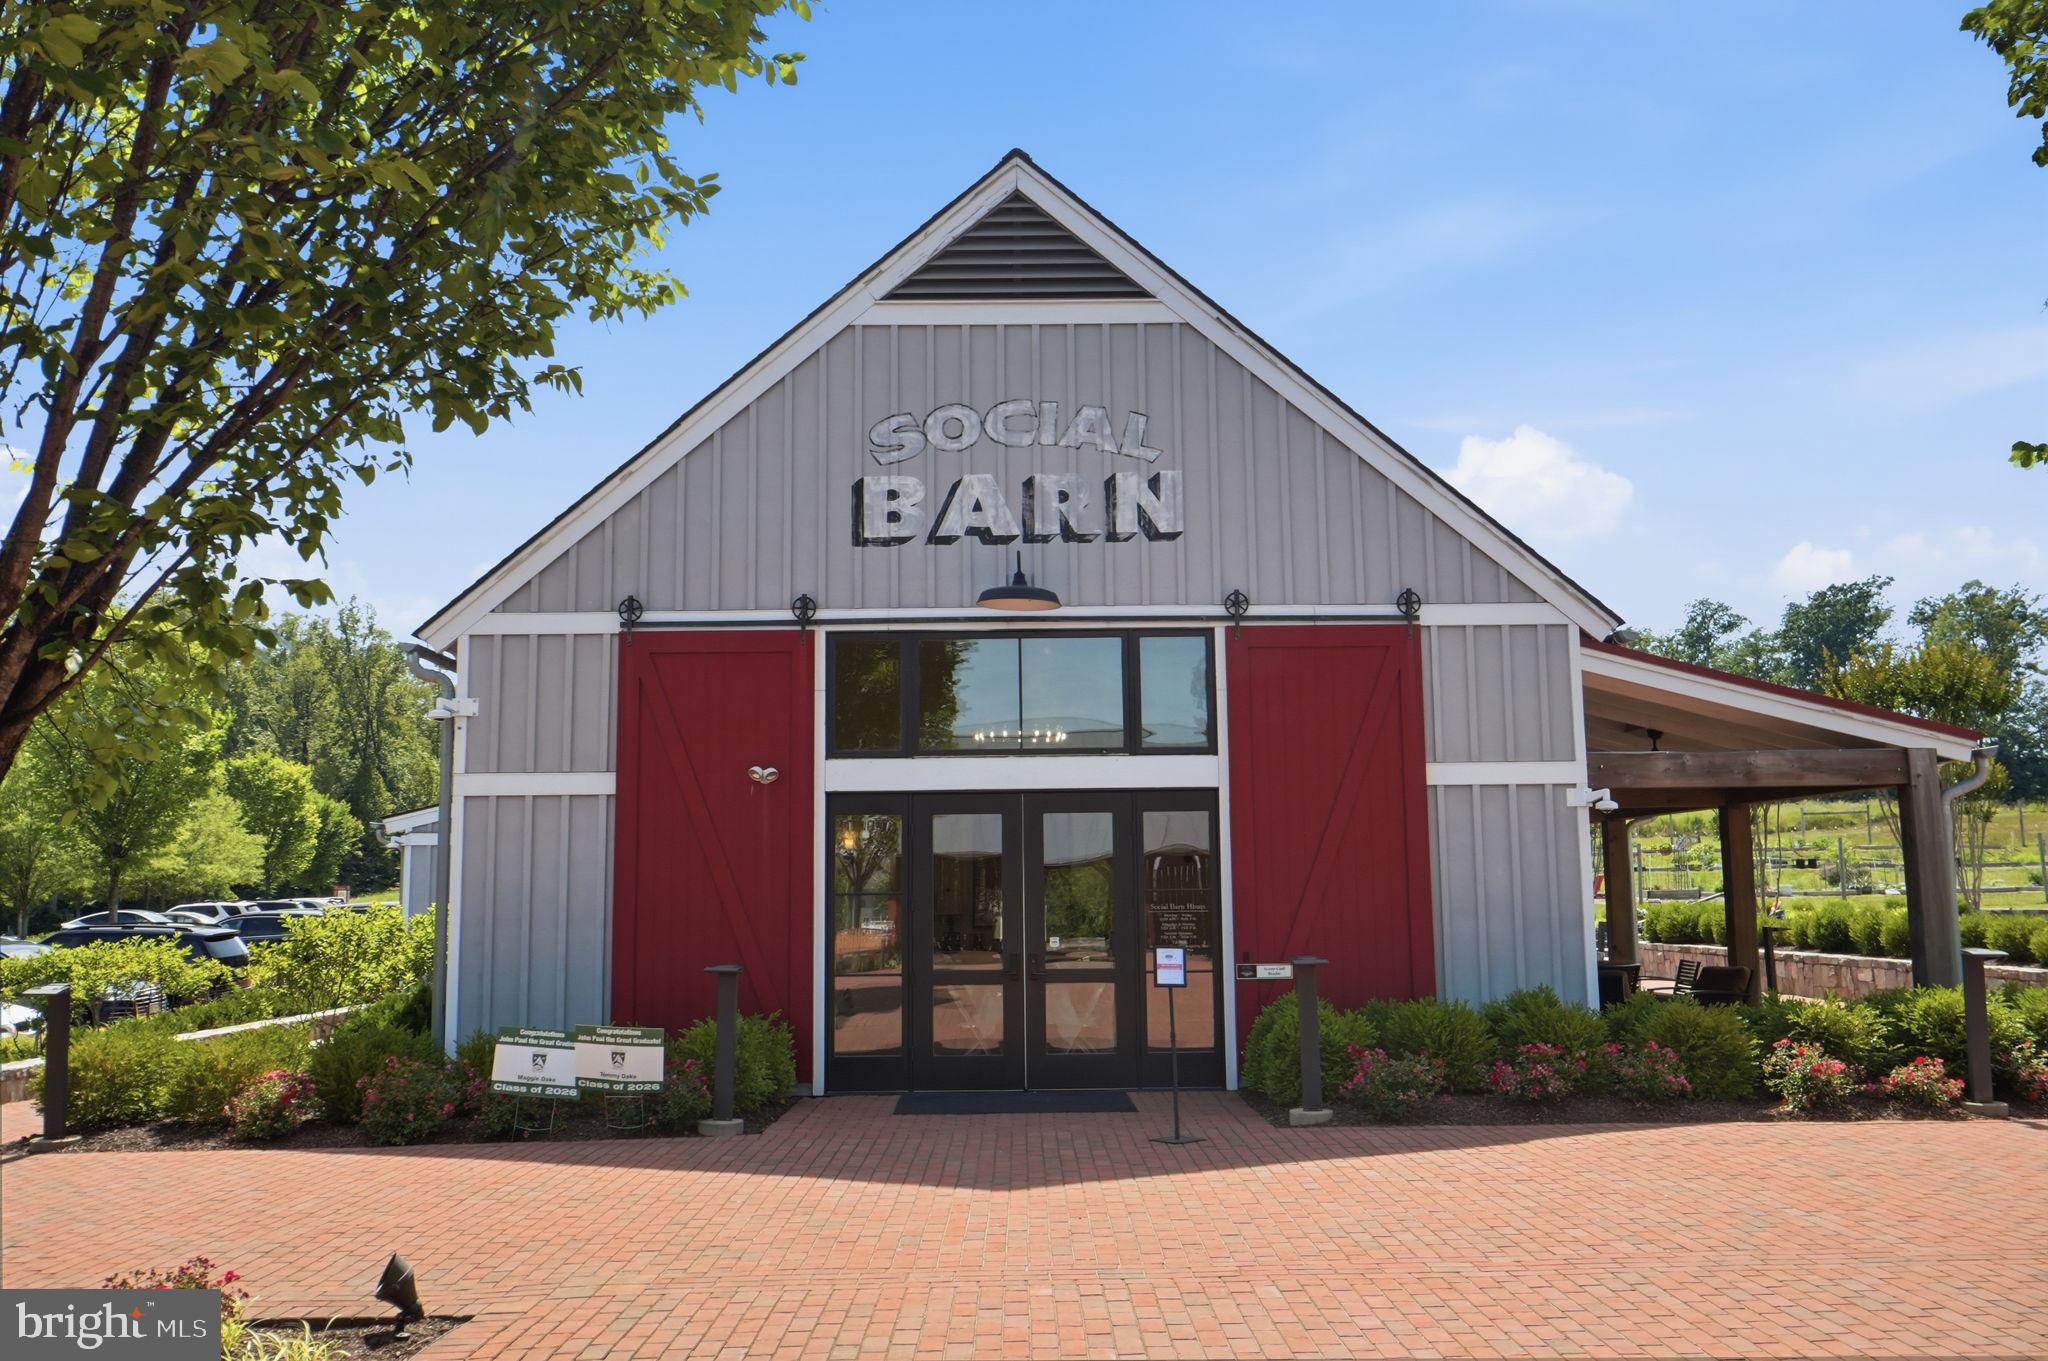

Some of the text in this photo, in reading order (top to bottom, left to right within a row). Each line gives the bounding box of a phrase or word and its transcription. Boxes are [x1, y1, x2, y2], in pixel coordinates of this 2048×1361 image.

[869, 398, 1163, 466] SOCIAL
[852, 470, 1184, 547] BARN
[493, 1083, 578, 1097] Class of 2026
[578, 1079, 660, 1091] Class of 2026
